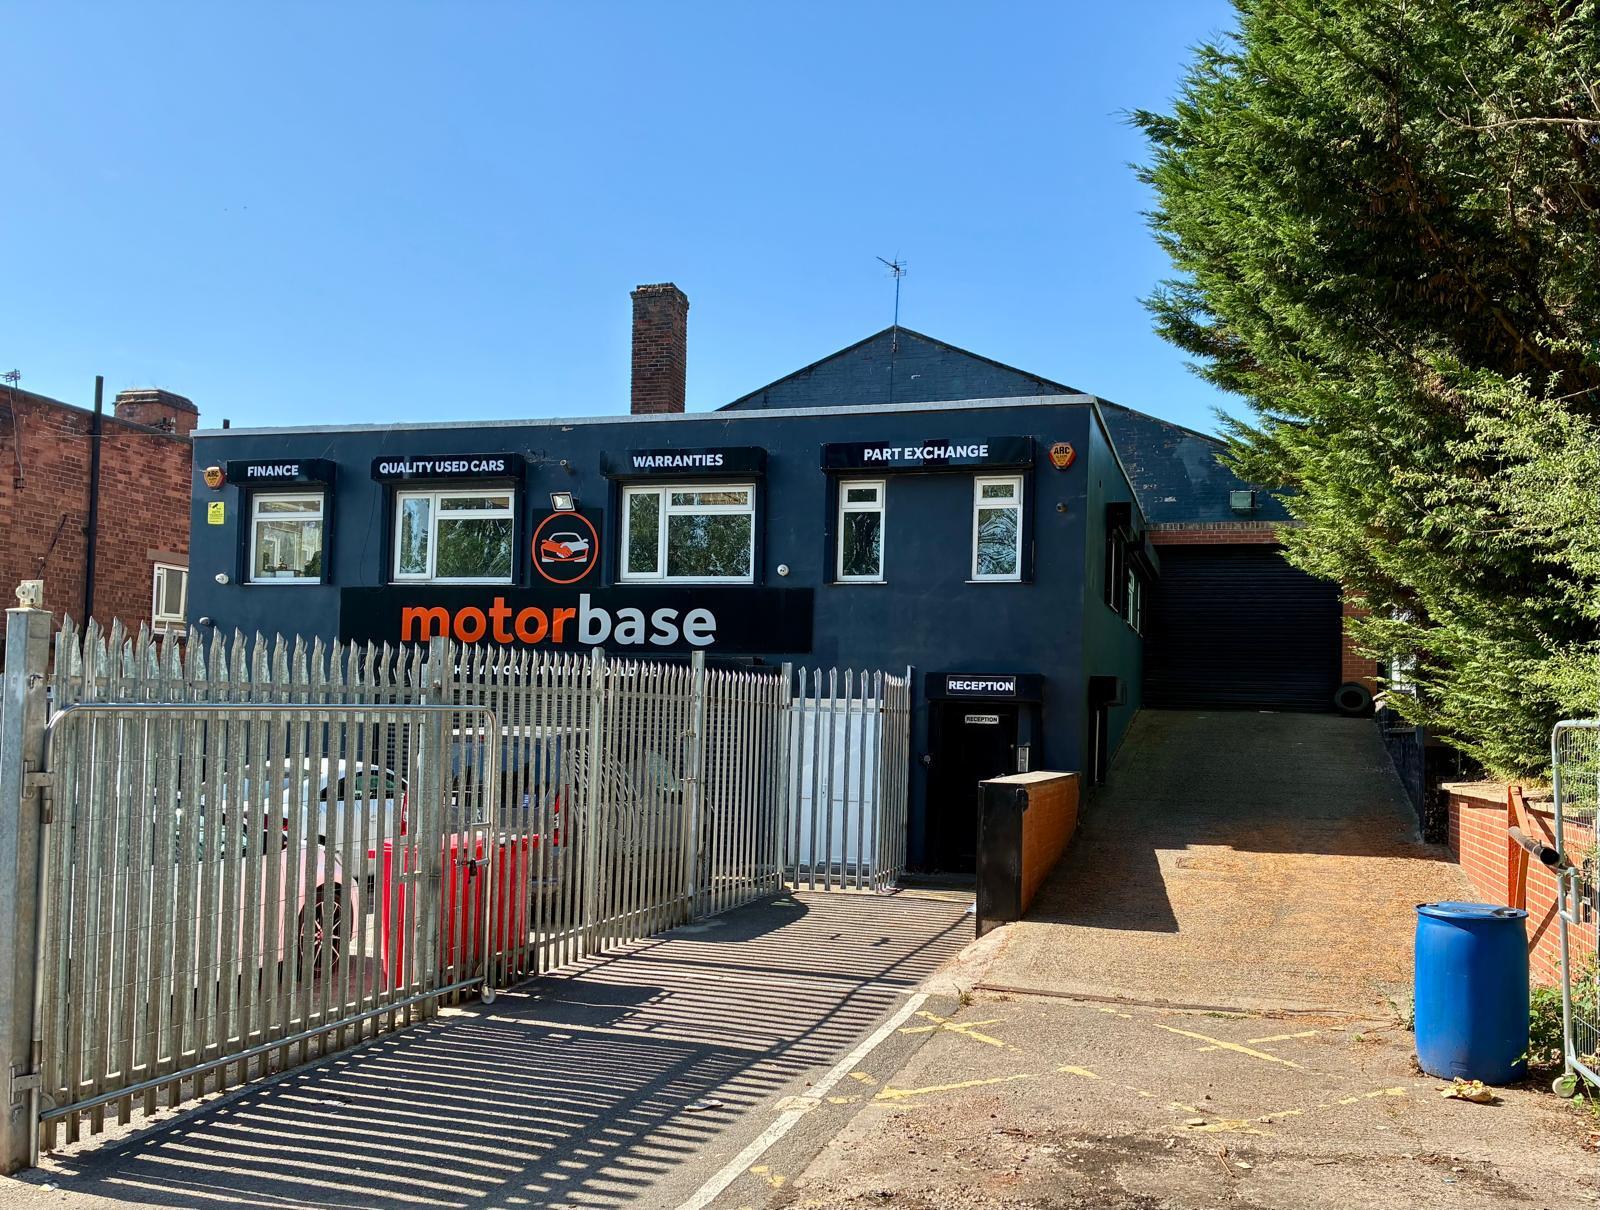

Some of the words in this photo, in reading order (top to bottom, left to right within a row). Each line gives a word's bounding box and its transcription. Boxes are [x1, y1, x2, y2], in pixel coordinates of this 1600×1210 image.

[864, 447, 901, 461] PART
[904, 444, 989, 459] EXCHANGE
[1053, 446, 1070, 455] ARC
[379, 461, 433, 474] QUALITY
[435, 460, 469, 473] USED
[470, 459, 505, 472] CARS
[632, 453, 724, 468] WARRANTIES
[247, 464, 299, 477] FINANCE
[401, 593, 717, 647] motorbase
[948, 680, 1014, 691] RECEPTION
